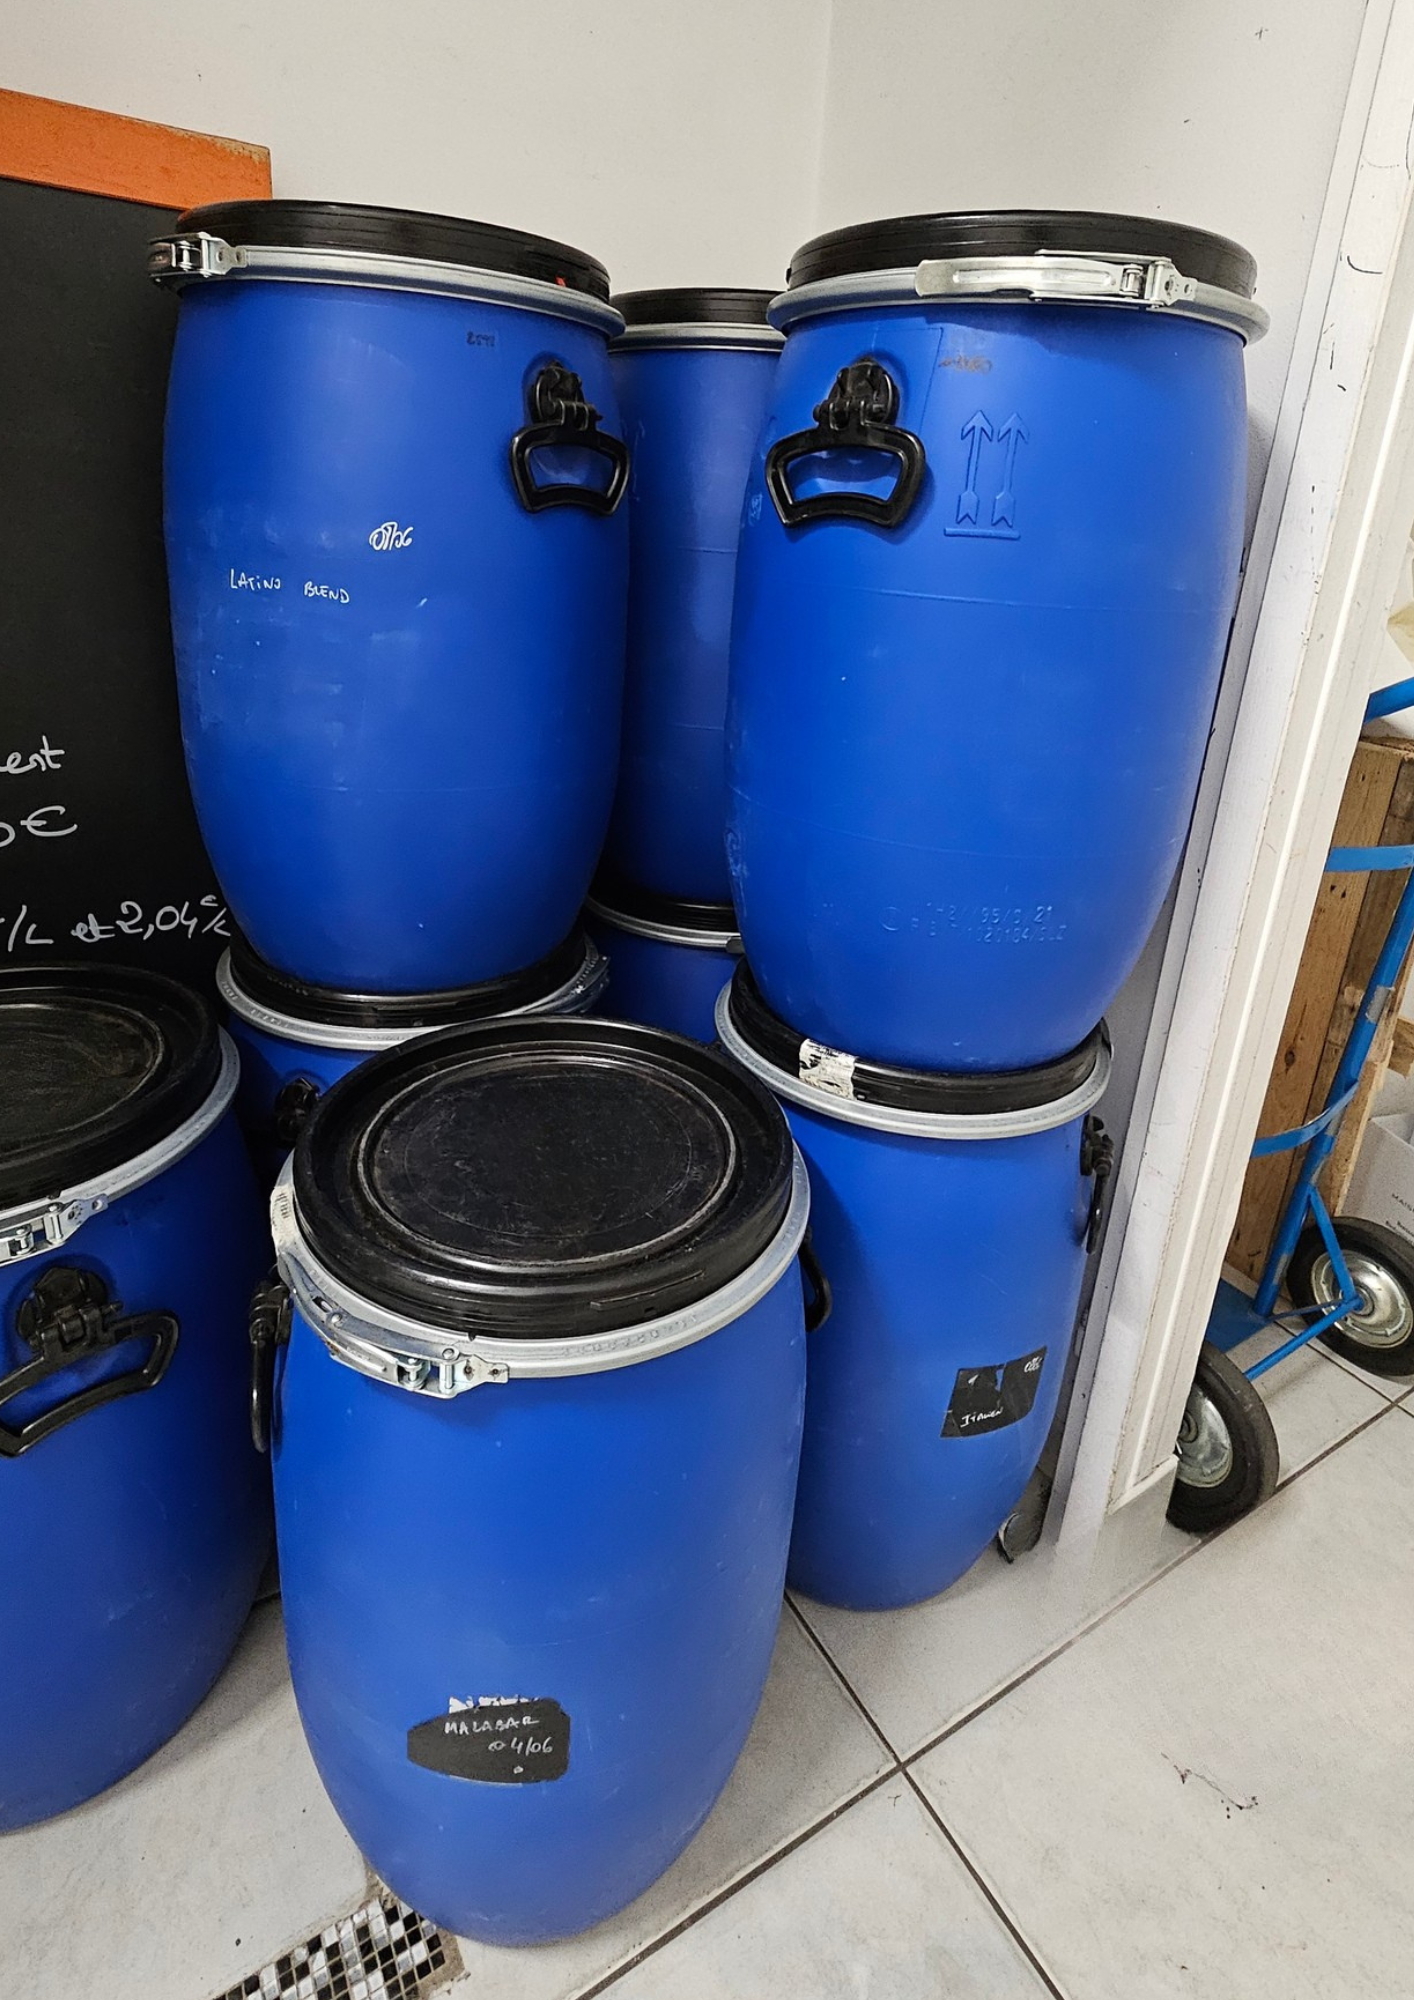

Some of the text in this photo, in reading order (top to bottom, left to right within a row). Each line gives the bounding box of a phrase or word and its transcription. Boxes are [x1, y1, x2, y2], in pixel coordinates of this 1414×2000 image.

[304, 580, 350, 603] BLEND
[0, 735, 65, 774] ent
[444, 1715, 540, 1735] MALABAR
